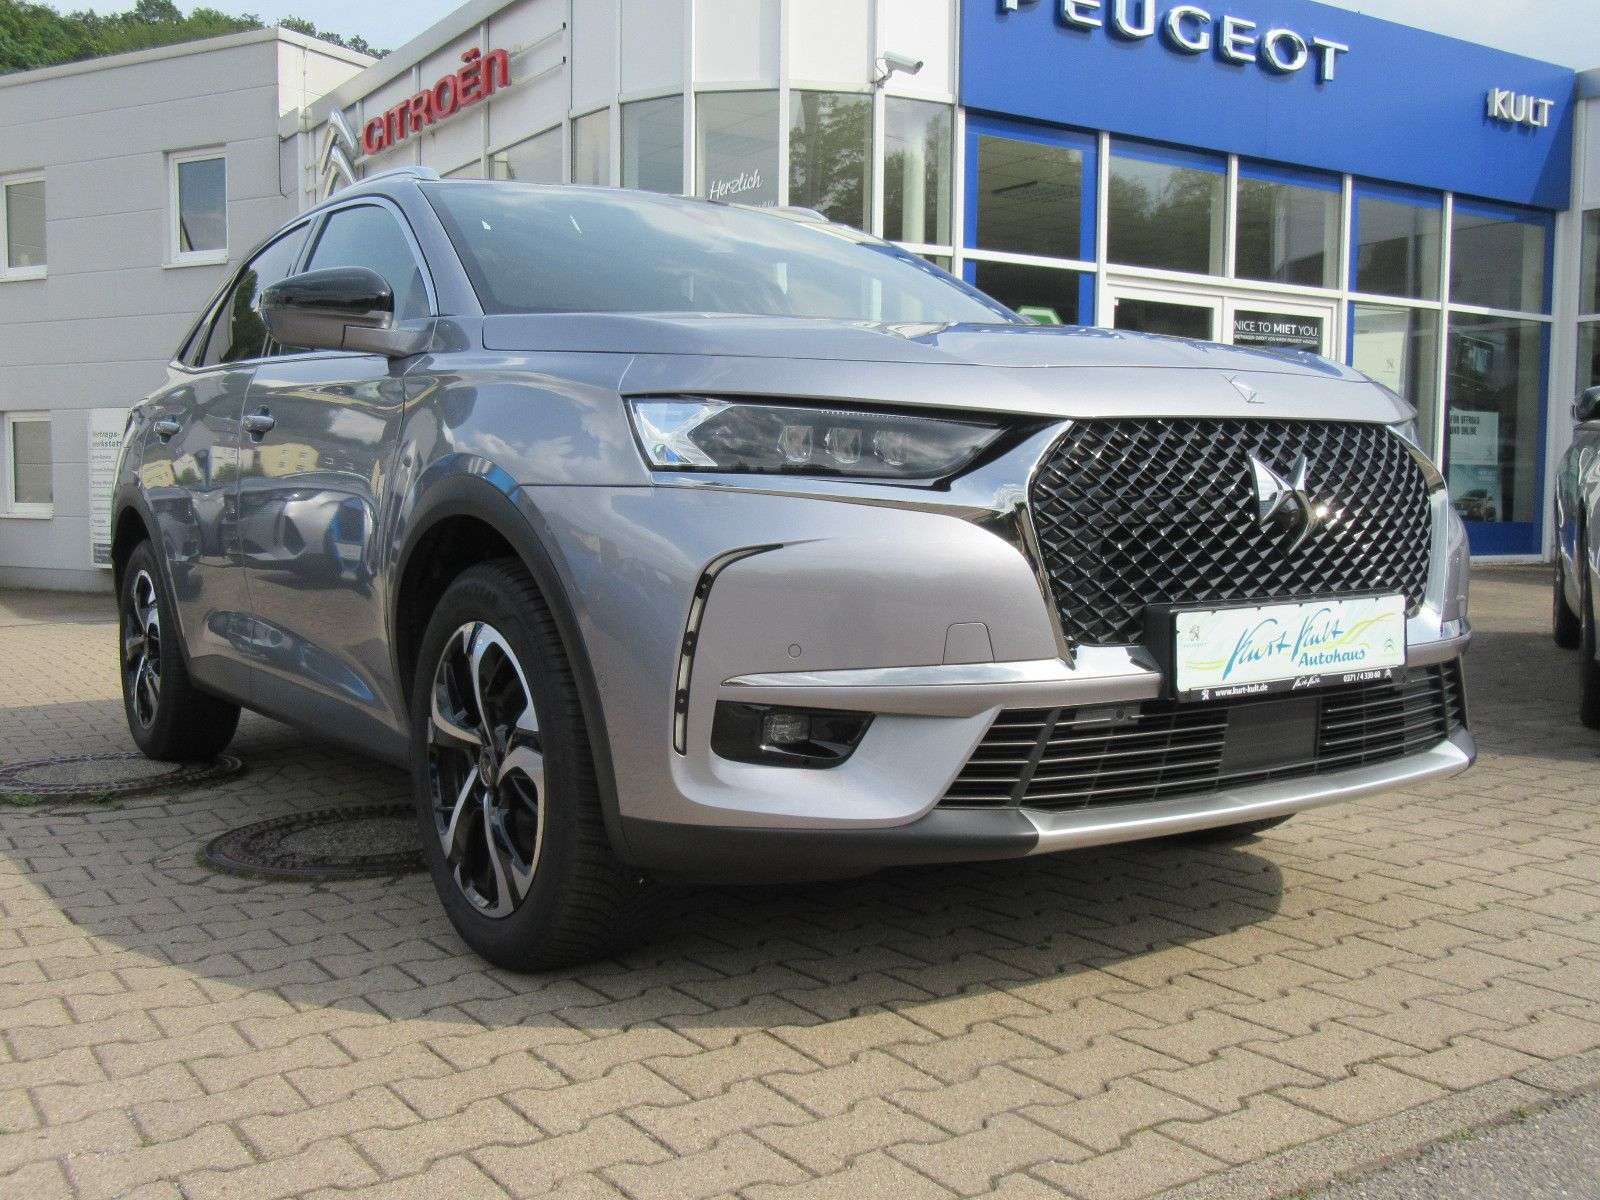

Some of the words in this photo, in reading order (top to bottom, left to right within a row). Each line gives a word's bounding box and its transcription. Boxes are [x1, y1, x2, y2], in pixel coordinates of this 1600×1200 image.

[1000, 0, 1349, 82] EUGEOT
[1490, 87, 1554, 127] KULT
[709, 168, 763, 200] Herzlich
[1234, 320, 1256, 332] NICE
[1259, 322, 1271, 333] TO
[1273, 323, 1296, 335] MIET
[1222, 618, 1291, 681] Kurt
[1291, 608, 1343, 662] Kult
[1298, 649, 1366, 667] Autohaus
[1215, 683, 1268, 697] www.kurt-kult.de
